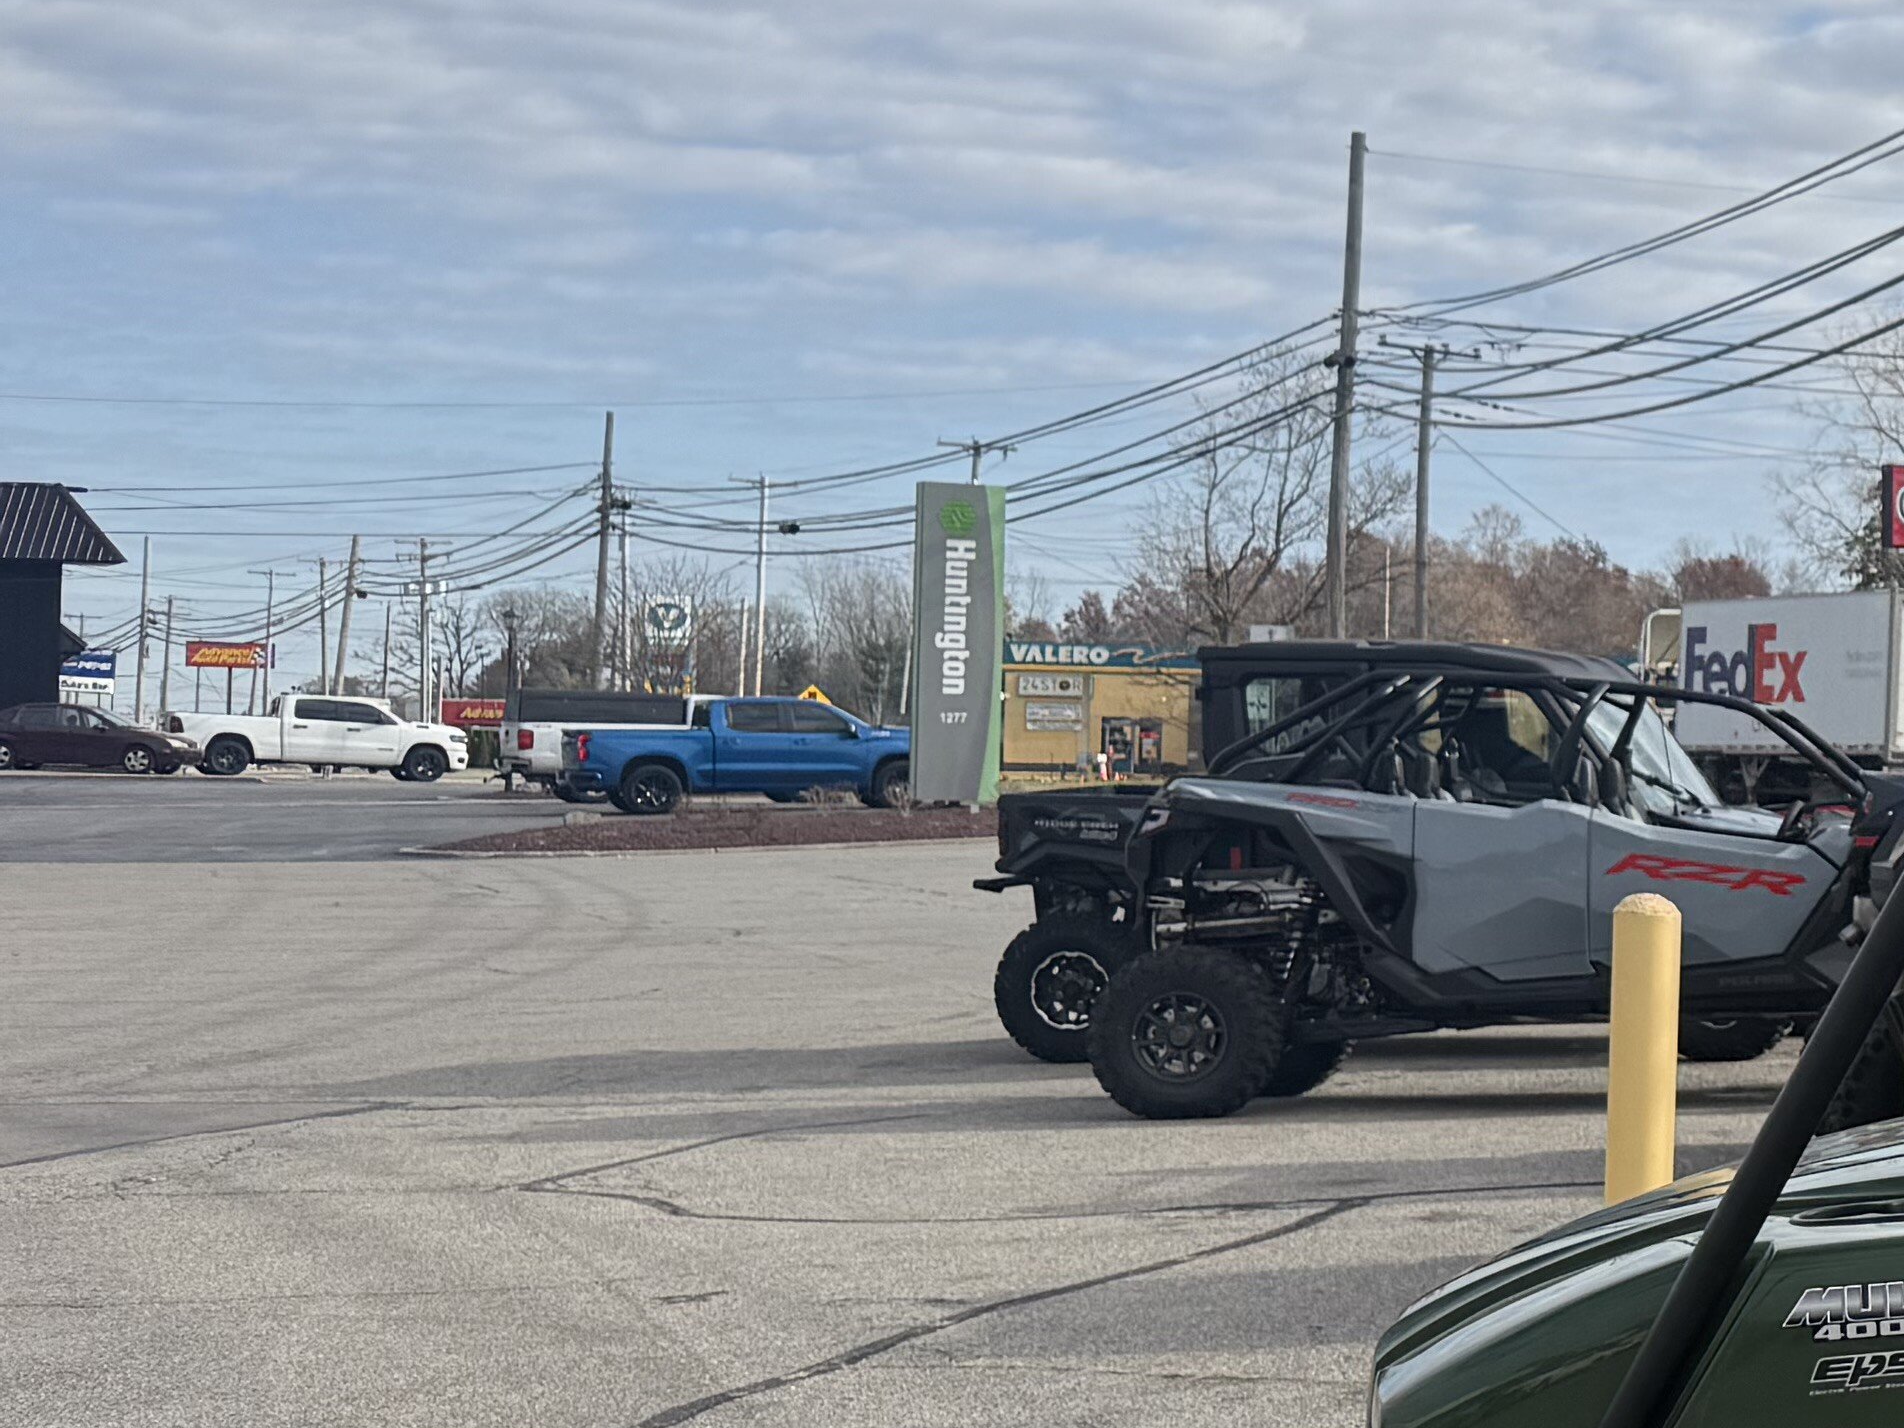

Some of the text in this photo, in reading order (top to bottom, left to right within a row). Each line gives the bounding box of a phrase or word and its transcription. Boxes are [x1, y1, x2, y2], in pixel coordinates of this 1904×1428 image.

[935, 538, 977, 695] Huntington
[1010, 643, 1110, 665] VALERO
[1684, 622, 1808, 705] FedEx
